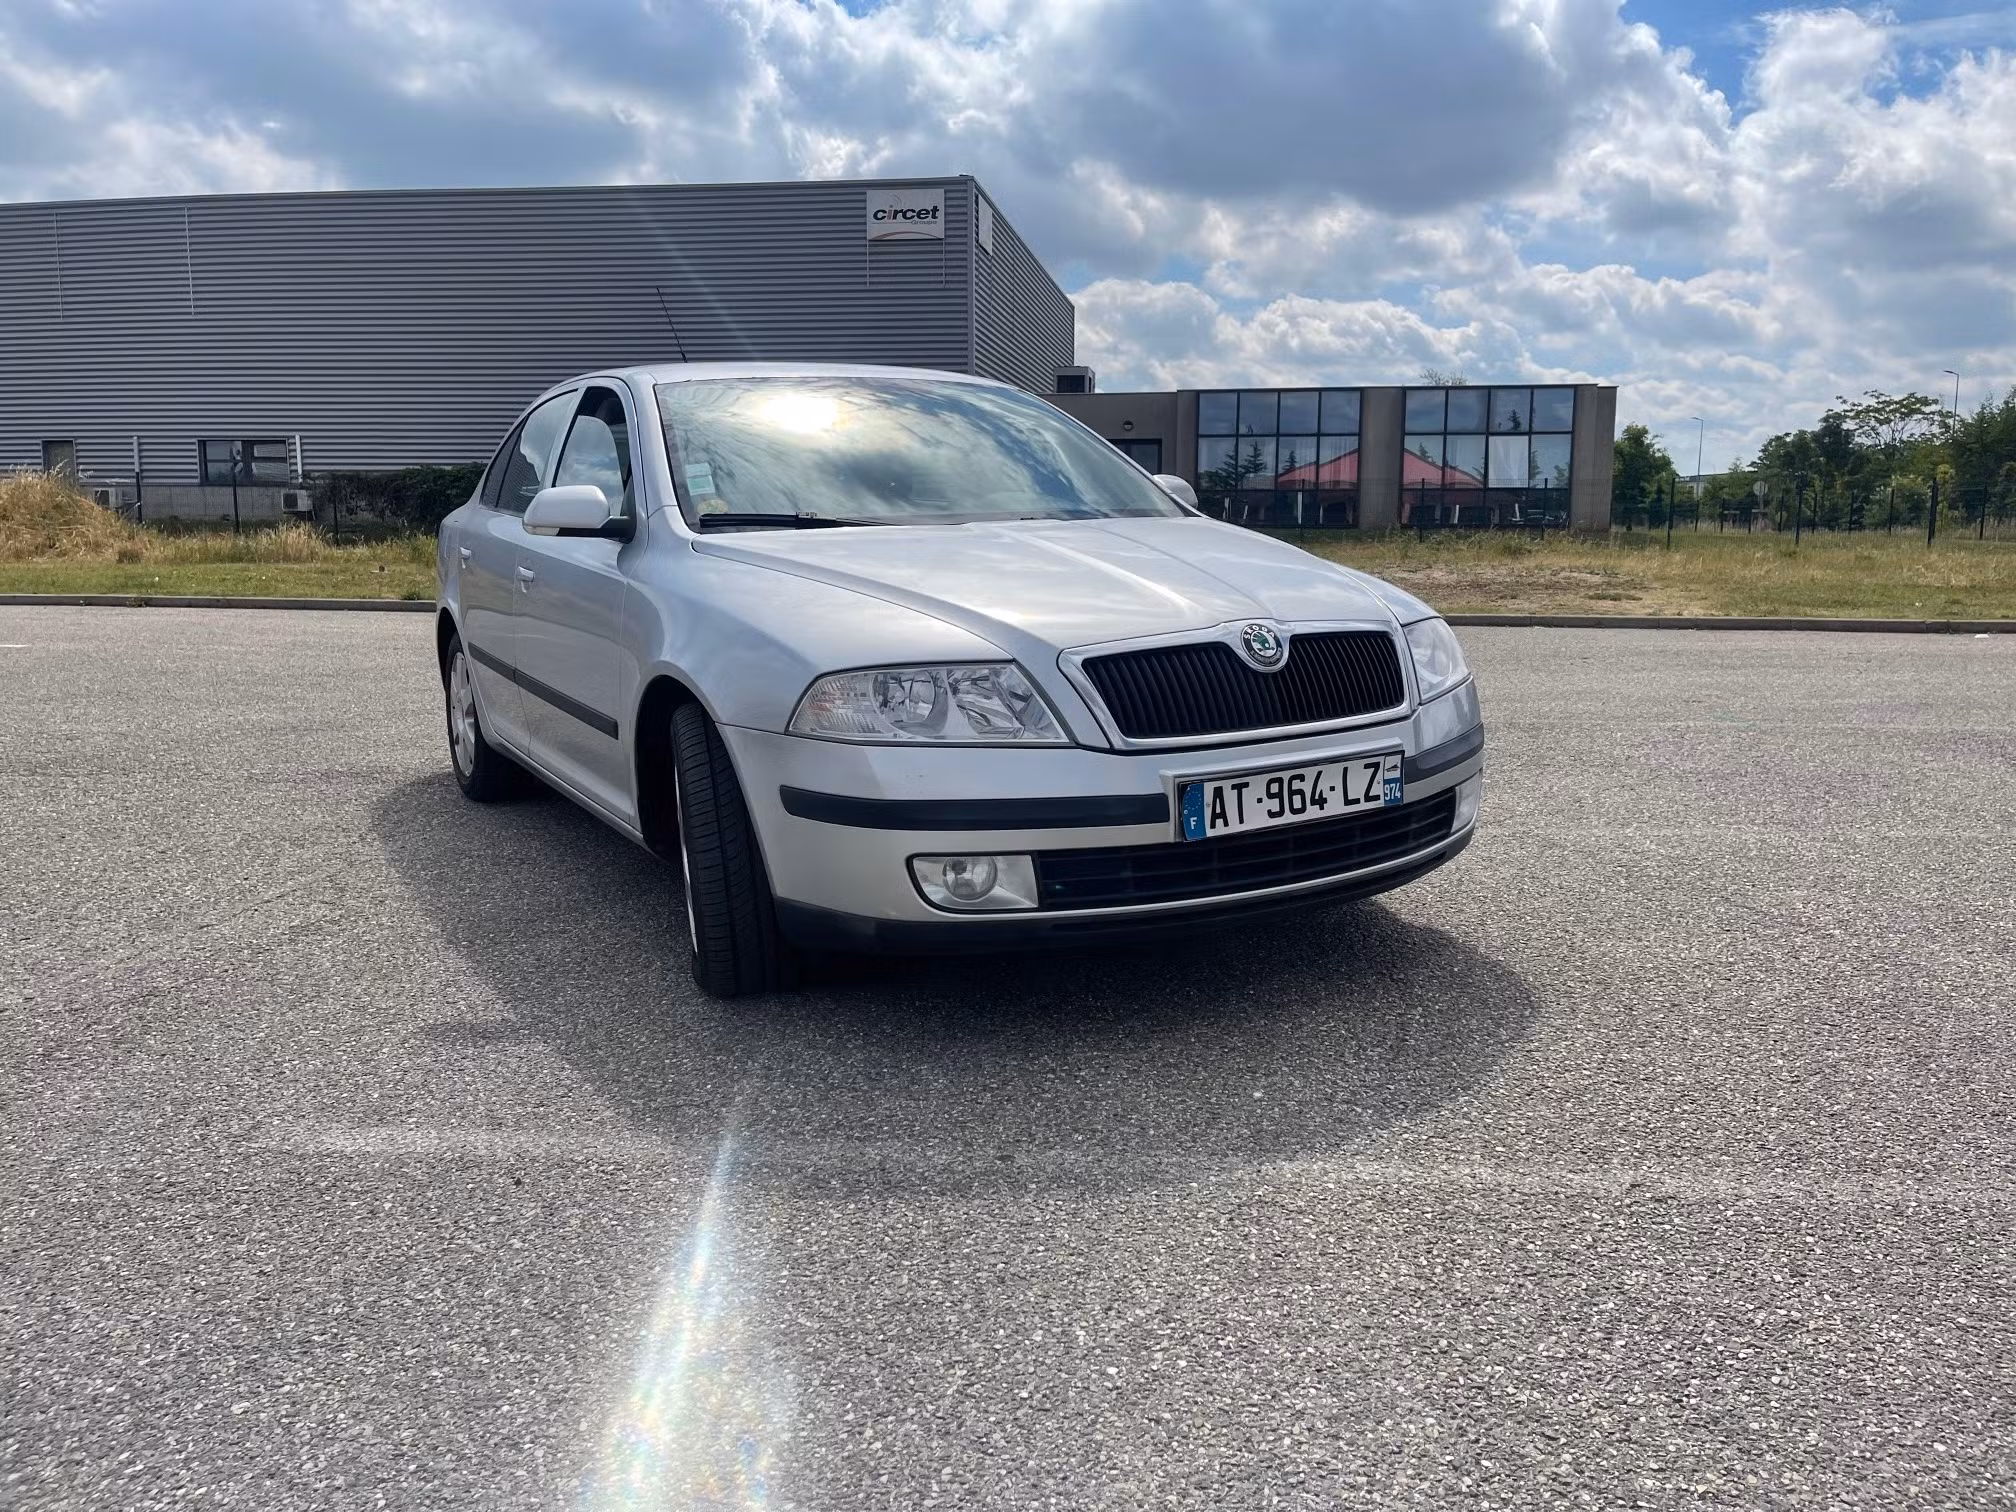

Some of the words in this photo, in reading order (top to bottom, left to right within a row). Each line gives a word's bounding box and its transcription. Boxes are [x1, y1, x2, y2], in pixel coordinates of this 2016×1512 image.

[873, 205, 940, 221] circet
[1210, 761, 1381, 830] AT-964-LZ
[1384, 782, 1401, 801] 974
[1189, 816, 1198, 830] F
